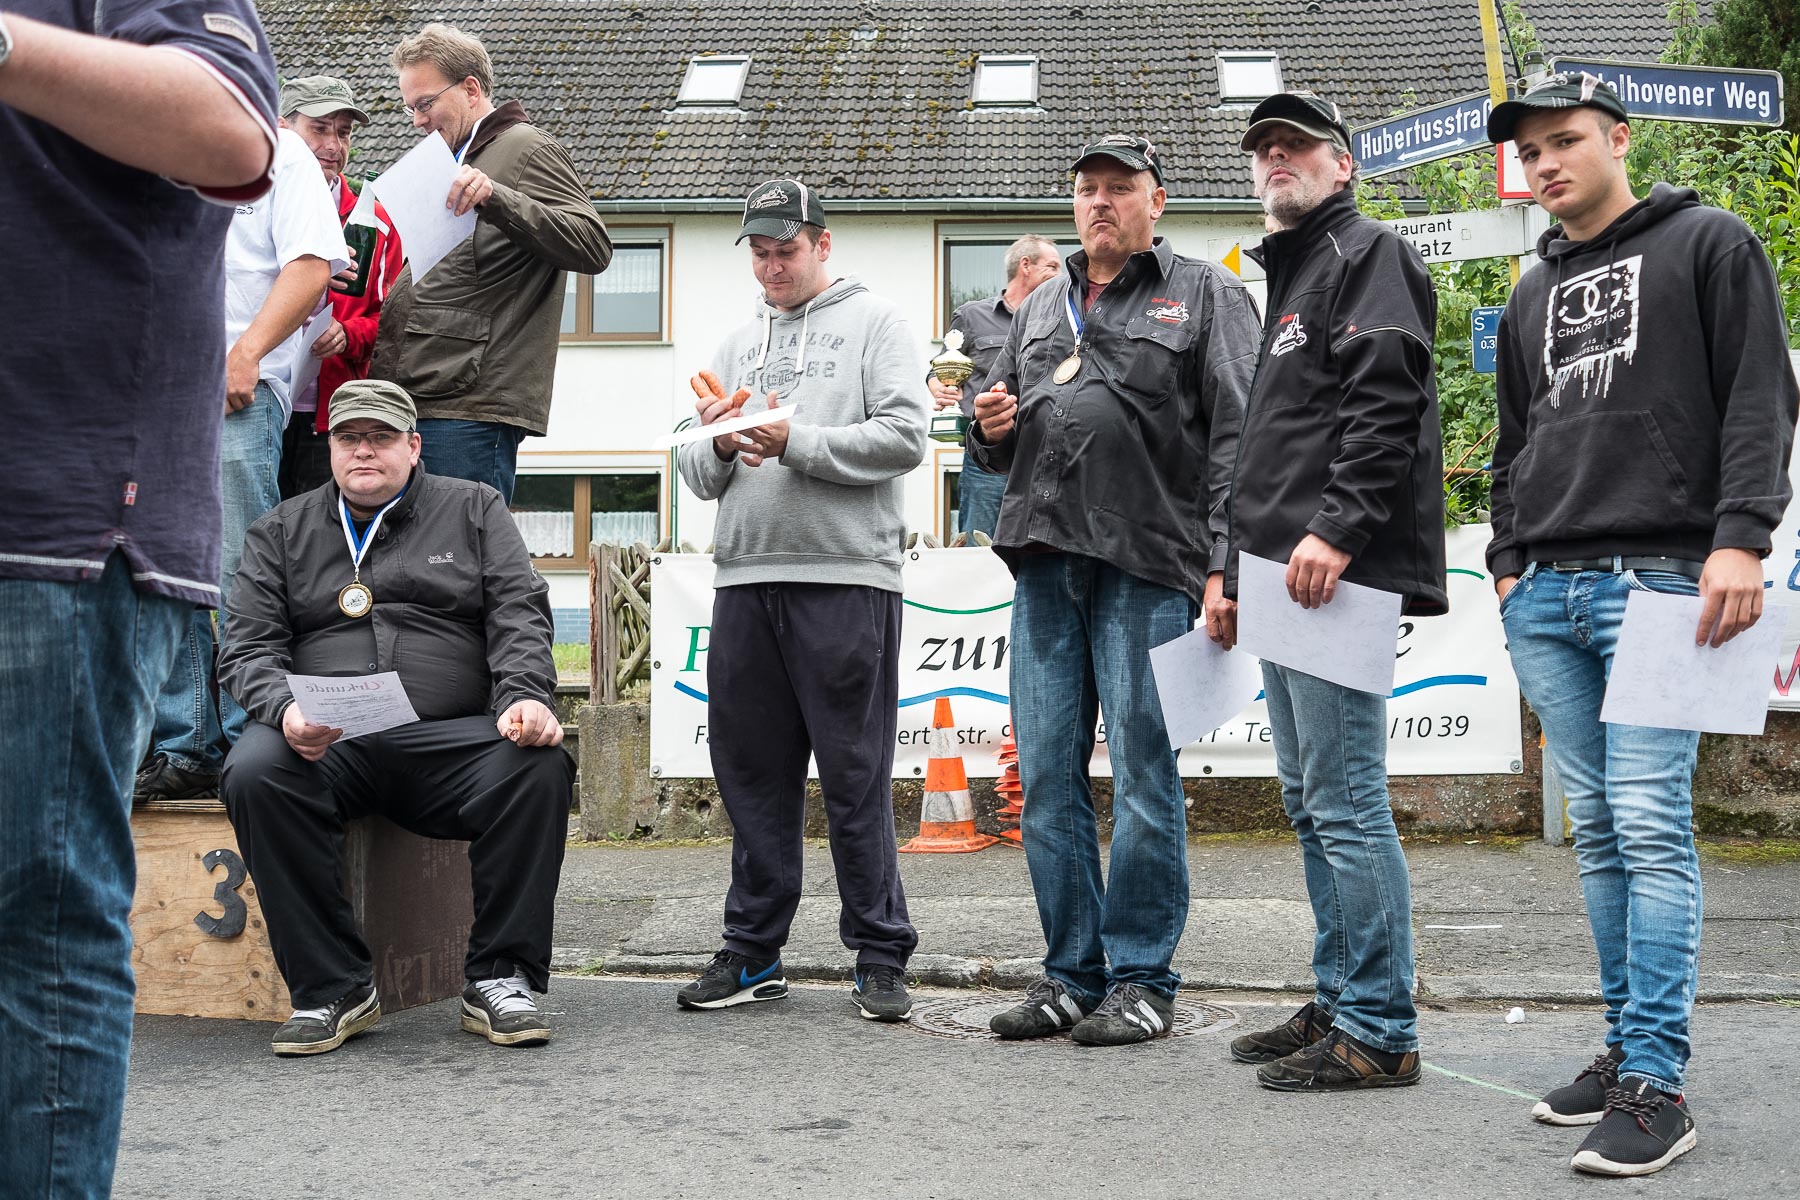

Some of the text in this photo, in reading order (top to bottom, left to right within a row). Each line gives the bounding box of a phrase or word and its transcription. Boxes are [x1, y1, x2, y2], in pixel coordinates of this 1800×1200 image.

[1723, 80, 1771, 118] Weg
[1474, 316, 1485, 331] S
[1557, 308, 1626, 338] CHAOS GANG
[193, 848, 248, 938] 3
